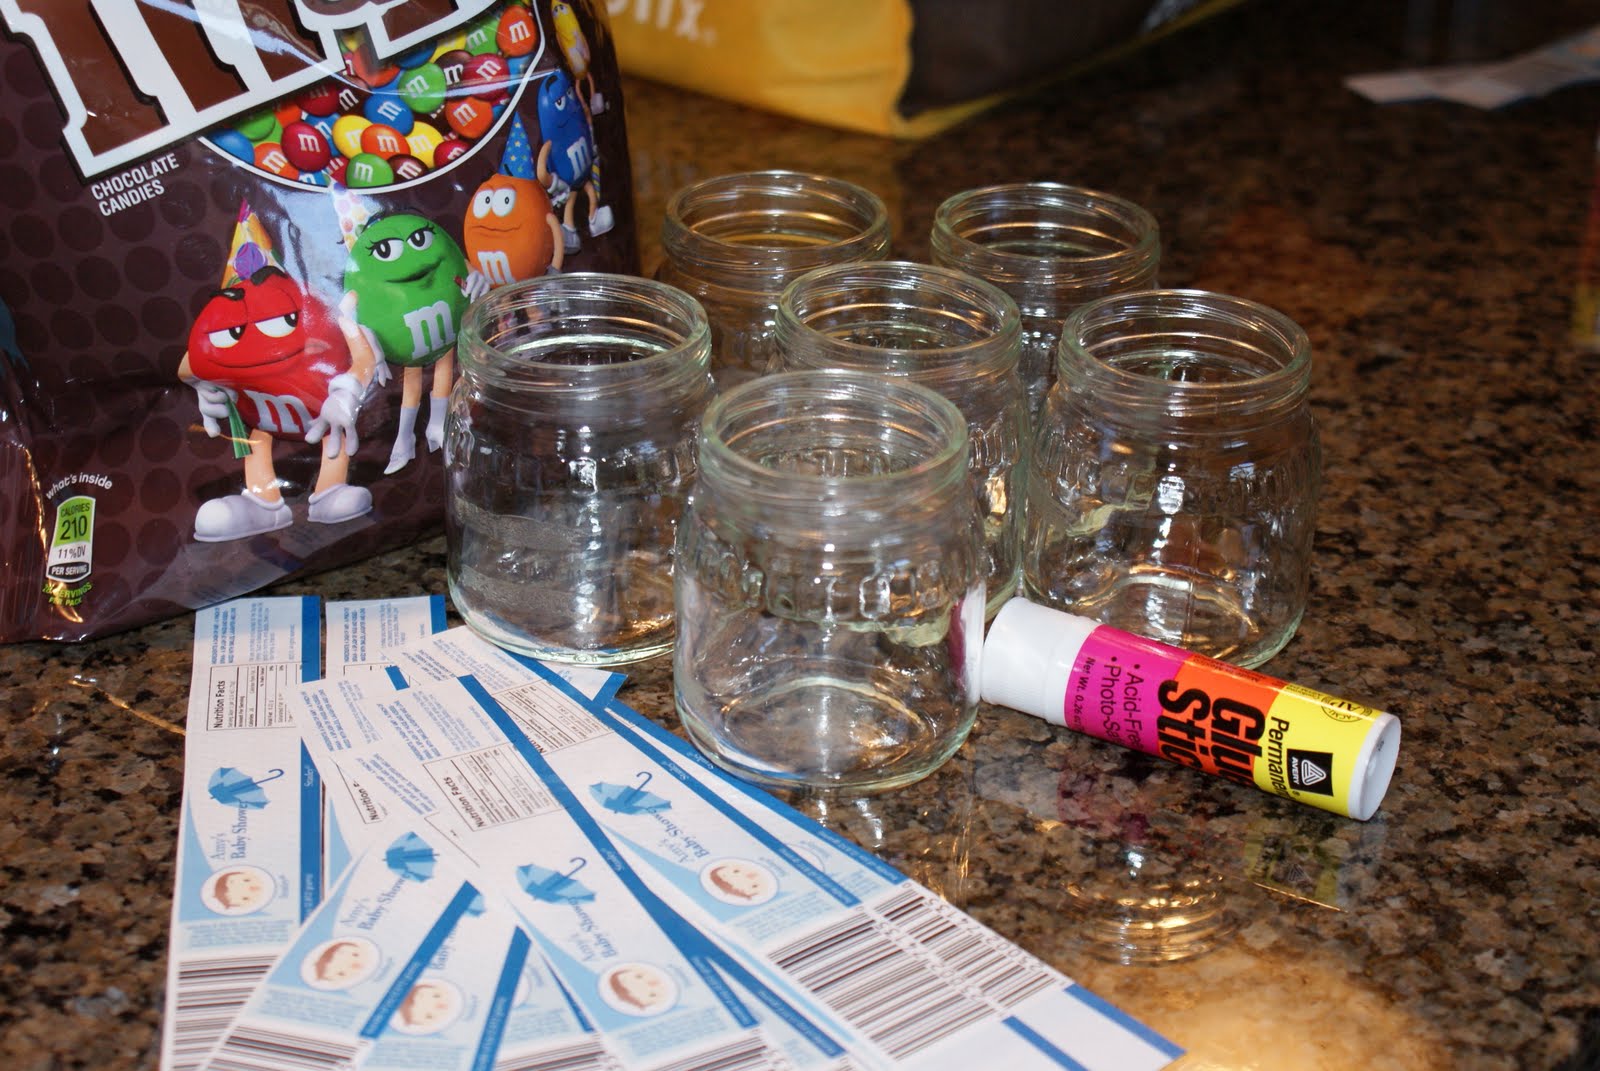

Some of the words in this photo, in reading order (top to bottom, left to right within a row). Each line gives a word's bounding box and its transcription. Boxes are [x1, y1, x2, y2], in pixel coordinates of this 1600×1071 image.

[508, 20, 531, 43] m
[476, 59, 502, 82] m
[405, 74, 430, 98] m
[338, 88, 360, 111] m
[377, 100, 402, 121] m
[453, 102, 477, 127] m
[298, 133, 321, 153] m
[377, 134, 400, 153] m
[262, 150, 288, 174] m
[397, 160, 422, 180] m
[567, 136, 593, 181] m
[91, 152, 180, 200] CHOCOLATE
[353, 161, 374, 183] m
[98, 179, 165, 216] CANDIES
[476, 250, 517, 286] m
[403, 300, 458, 361] m
[243, 390, 318, 433] m
[45, 473, 78, 501] what's
[78, 471, 113, 490] inside
[60, 502, 91, 518] CALORIES
[60, 515, 88, 541] 210
[51, 565, 65, 576] PER
[65, 564, 88, 576] SERVING
[54, 581, 93, 599] ERVINGS
[1083, 657, 1097, 675] Net
[215, 680, 225, 697] Facts
[1076, 675, 1090, 693] Wt.
[213, 698, 224, 727] Nutrition
[1073, 694, 1085, 715] 0.26
[1290, 756, 1301, 786] AVERY
[442, 775, 462, 795] Facts
[358, 788, 379, 820] Nutrition
[458, 796, 485, 827] Nutrition
[231, 835, 249, 858] Baby
[680, 837, 709, 858] Baby
